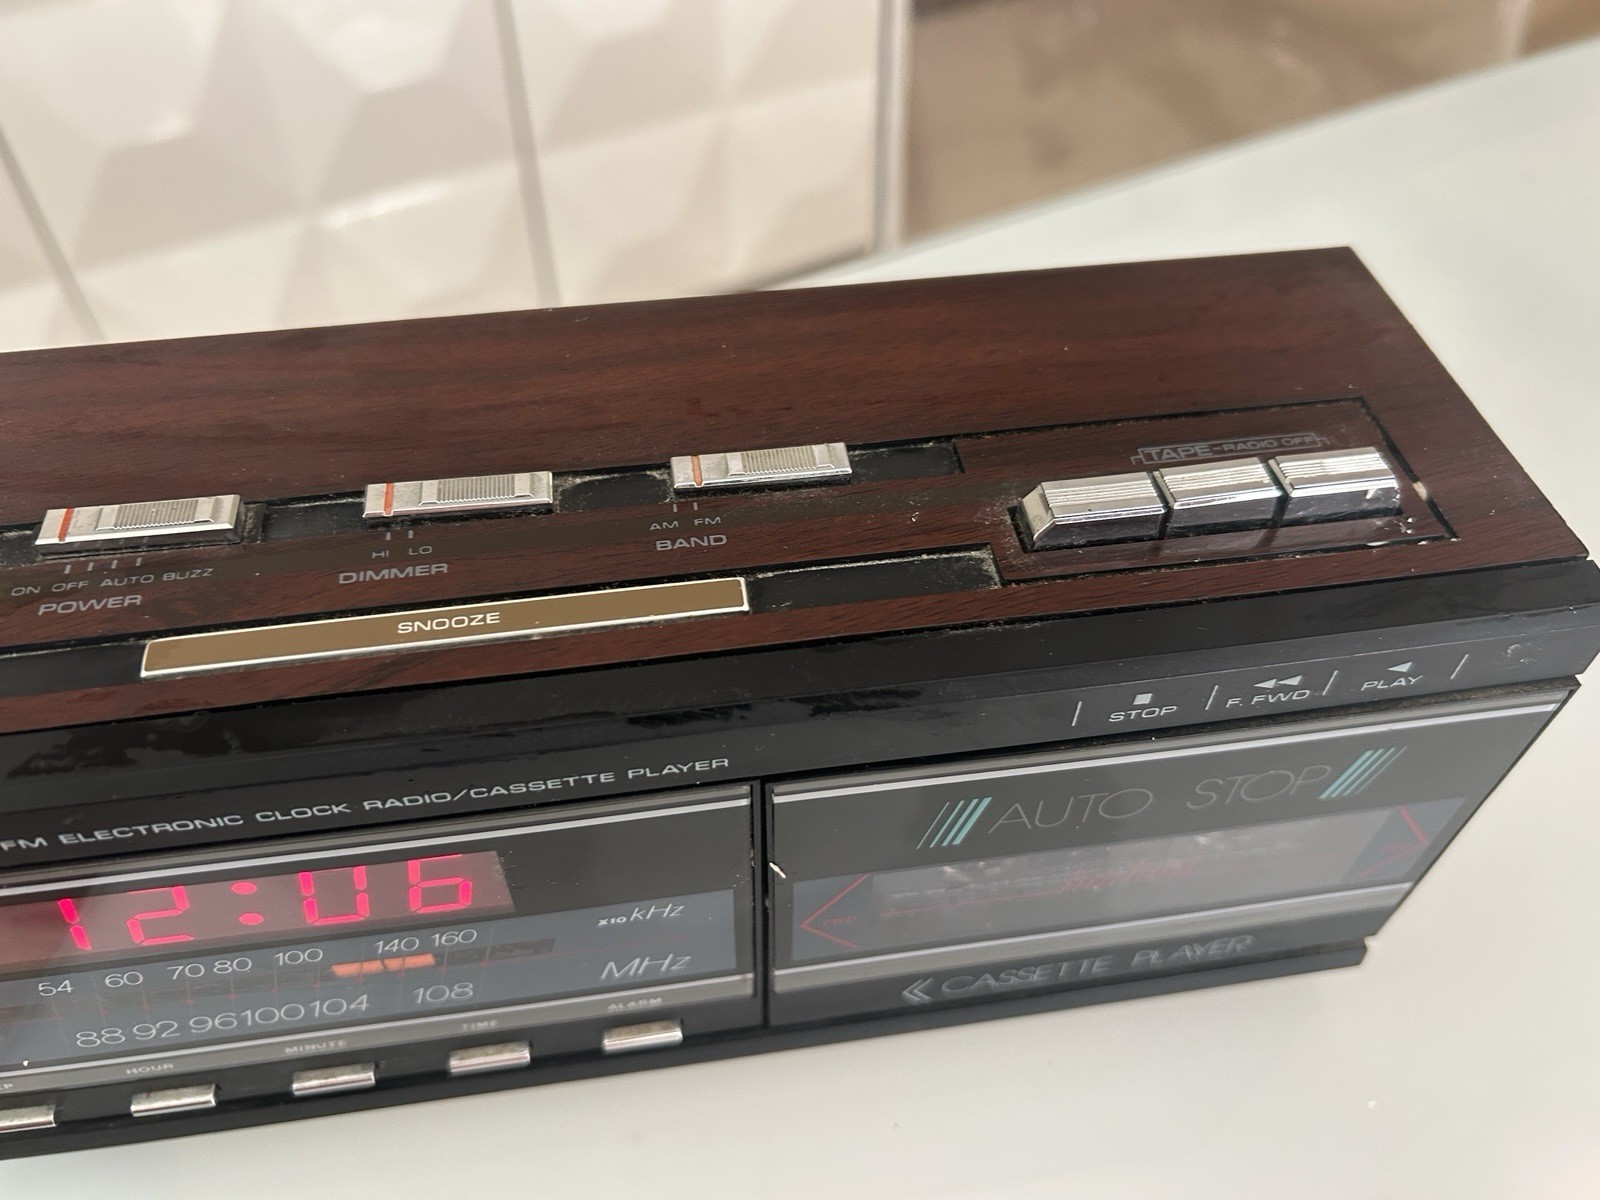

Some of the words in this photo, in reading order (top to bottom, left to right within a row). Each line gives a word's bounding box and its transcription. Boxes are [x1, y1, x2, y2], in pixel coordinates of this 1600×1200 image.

[649, 520, 679, 531] AM
[693, 516, 722, 527] FM
[654, 533, 728, 552] BAND
[338, 562, 449, 585] DIMMER
[371, 549, 390, 559] HI
[408, 545, 434, 556] LO
[10, 585, 41, 597] ON
[51, 580, 90, 593] OFF
[100, 573, 155, 588] AUTO
[162, 567, 215, 582] BUZZ
[37, 594, 143, 616] POWER
[397, 612, 501, 635] SNOOZE
[1108, 705, 1178, 723] STOP
[1360, 674, 1424, 692] PLAY
[58, 814, 245, 846] ELECTRONIC
[255, 803, 352, 824] CLOCK
[364, 771, 616, 811] RADIO/CASSETTE
[627, 757, 730, 780] PLAYER
[988, 787, 1154, 834] AUTO
[1186, 764, 1333, 810] STOP
[57, 852, 473, 951] 12:06
[37, 979, 75, 997] 54
[104, 970, 145, 988] 60
[166, 963, 206, 981] 70
[212, 957, 253, 974] 80
[273, 947, 324, 966] 100
[374, 935, 420, 955] 140
[429, 927, 478, 948] 160
[939, 957, 1111, 998] CASSETTE
[1130, 933, 1258, 970] PLAYER
[75, 1027, 126, 1048] 88
[132, 1020, 182, 1041] 92
[188, 1012, 238, 1034] 96
[240, 1002, 306, 1027] 100
[306, 993, 371, 1019] 104
[411, 981, 475, 1006] 108
[598, 951, 693, 981] MHz
[125, 1062, 175, 1075] HOUR
[285, 1039, 349, 1054] MINUTE
[607, 996, 664, 1013] ALARM
